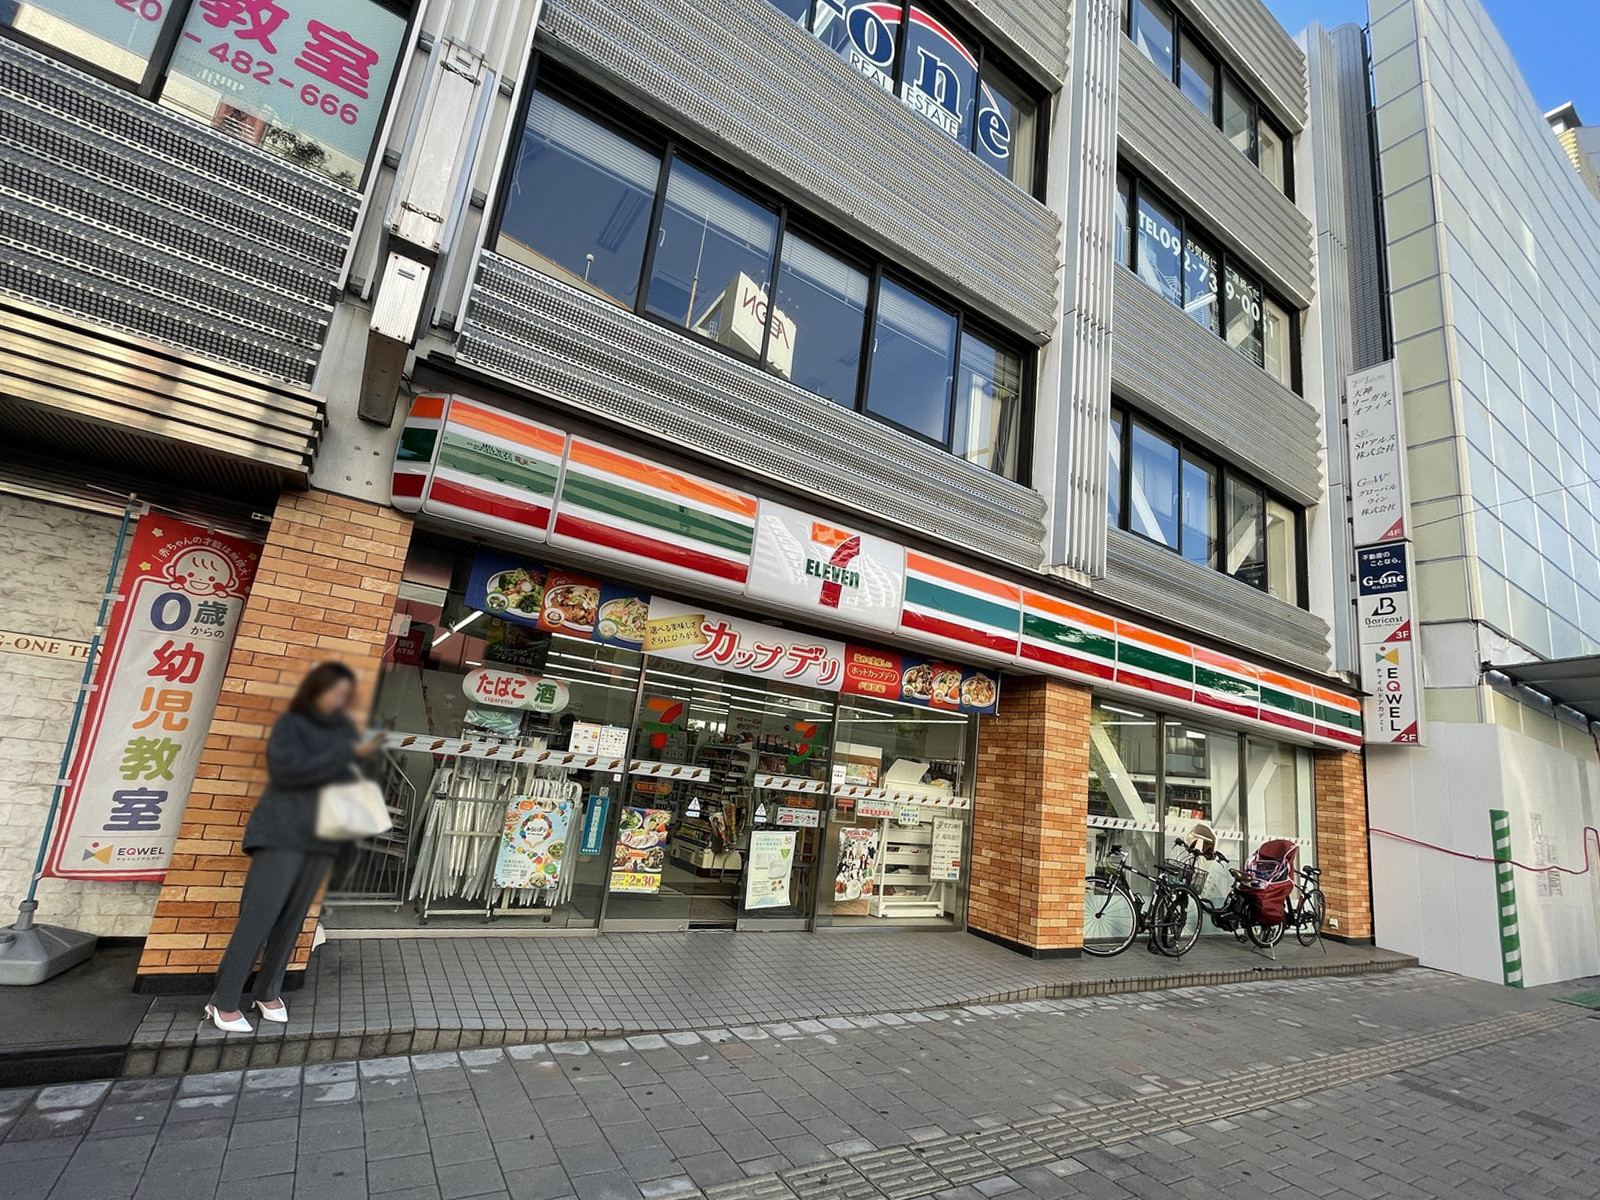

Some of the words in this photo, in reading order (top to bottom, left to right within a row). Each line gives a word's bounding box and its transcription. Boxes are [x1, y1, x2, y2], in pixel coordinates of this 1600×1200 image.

[198, 0, 380, 100] 教室
[905, 87, 958, 136] ESTATE
[1387, 529, 1401, 539] 4F
[1362, 571, 1405, 587] G-one
[190, 626, 226, 639] からの
[649, 620, 698, 636] 選べる美味しさ
[1396, 630, 1410, 640] 3F
[650, 631, 700, 646] さらにひろがる
[693, 619, 840, 685] カップデリ
[851, 666, 897, 682] ホットカップデリ
[475, 673, 528, 700] たばこ
[533, 682, 558, 705] 酒
[1386, 667, 1403, 732] EQWEL
[102, 639, 206, 832] 幼児教室
[1400, 733, 1416, 742] 2F
[117, 846, 165, 857] EQWEL
